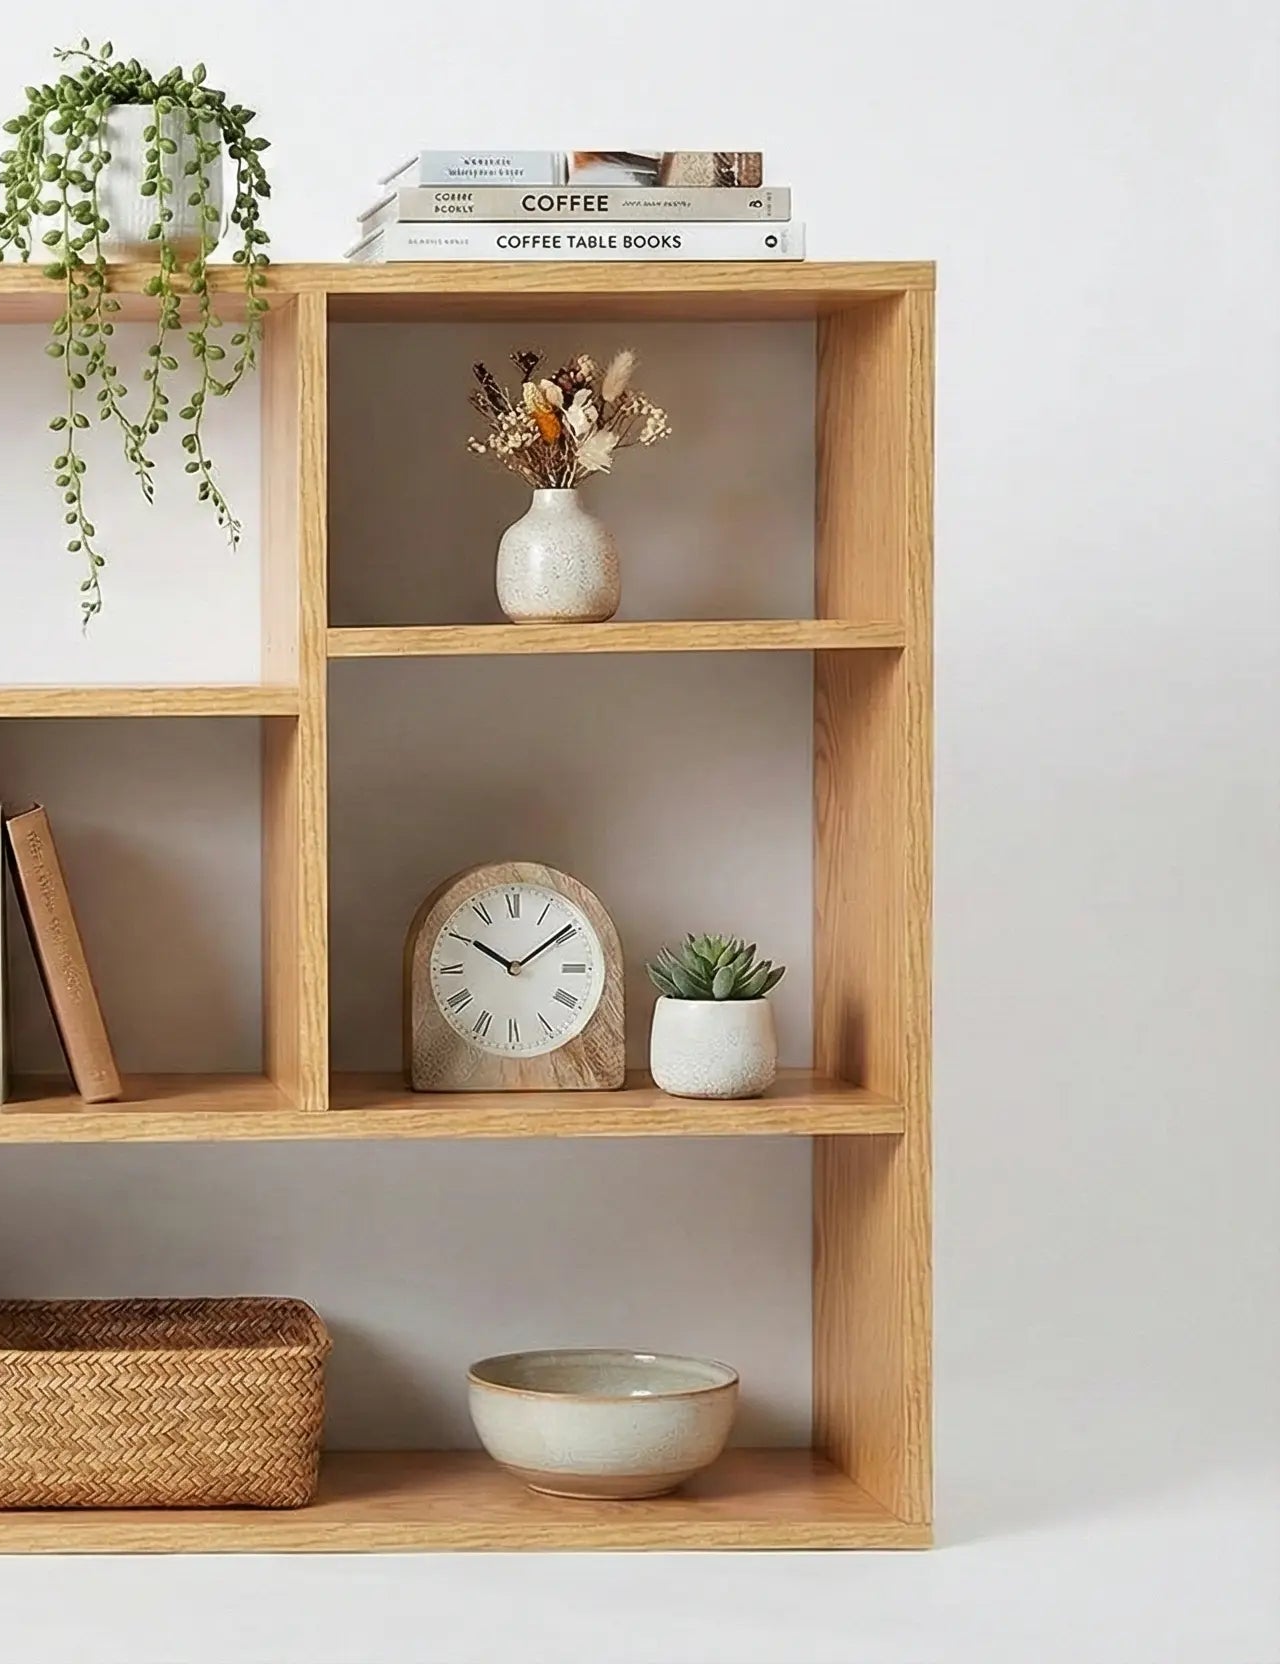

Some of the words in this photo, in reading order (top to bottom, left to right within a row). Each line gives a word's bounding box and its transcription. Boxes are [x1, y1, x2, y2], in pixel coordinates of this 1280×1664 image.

[521, 194, 609, 212] COFFEE
[496, 235, 562, 249] COFFEE
[566, 235, 617, 249] TABLE
[623, 235, 682, 249] BOOKS
